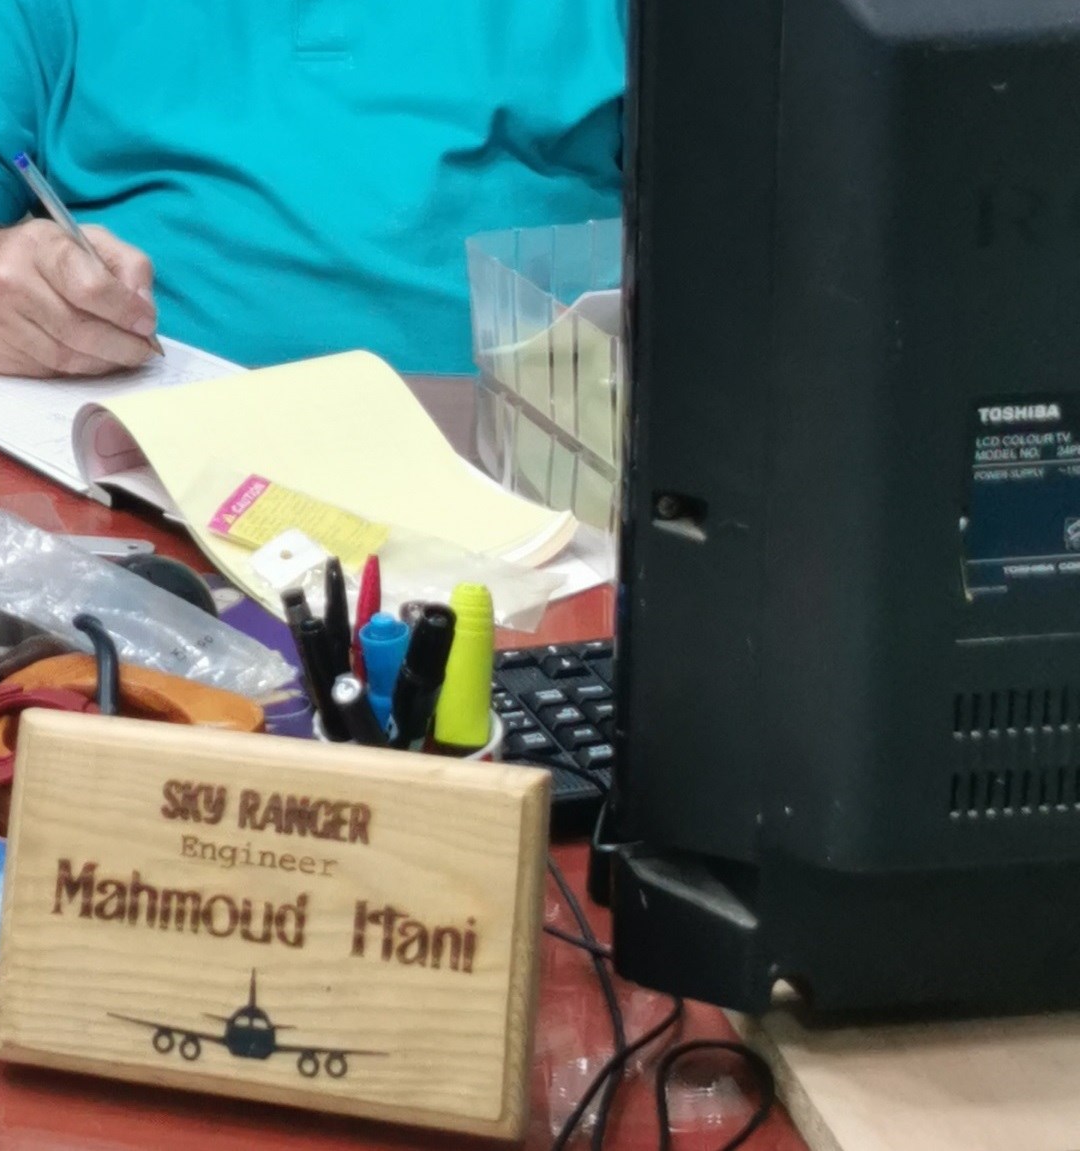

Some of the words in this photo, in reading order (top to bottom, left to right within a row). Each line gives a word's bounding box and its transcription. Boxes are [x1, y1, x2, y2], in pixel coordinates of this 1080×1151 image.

[978, 404, 1061, 425] TOSHIBA
[975, 436, 1000, 448] LCD
[1002, 433, 1054, 448] COLOUR
[1056, 432, 1072, 443] TV
[975, 448, 1018, 461] MODEL
[161, 779, 229, 824] SKY
[237, 789, 374, 846] RANGER
[180, 835, 340, 878] Engineer
[51, 858, 309, 950] Mahmoud
